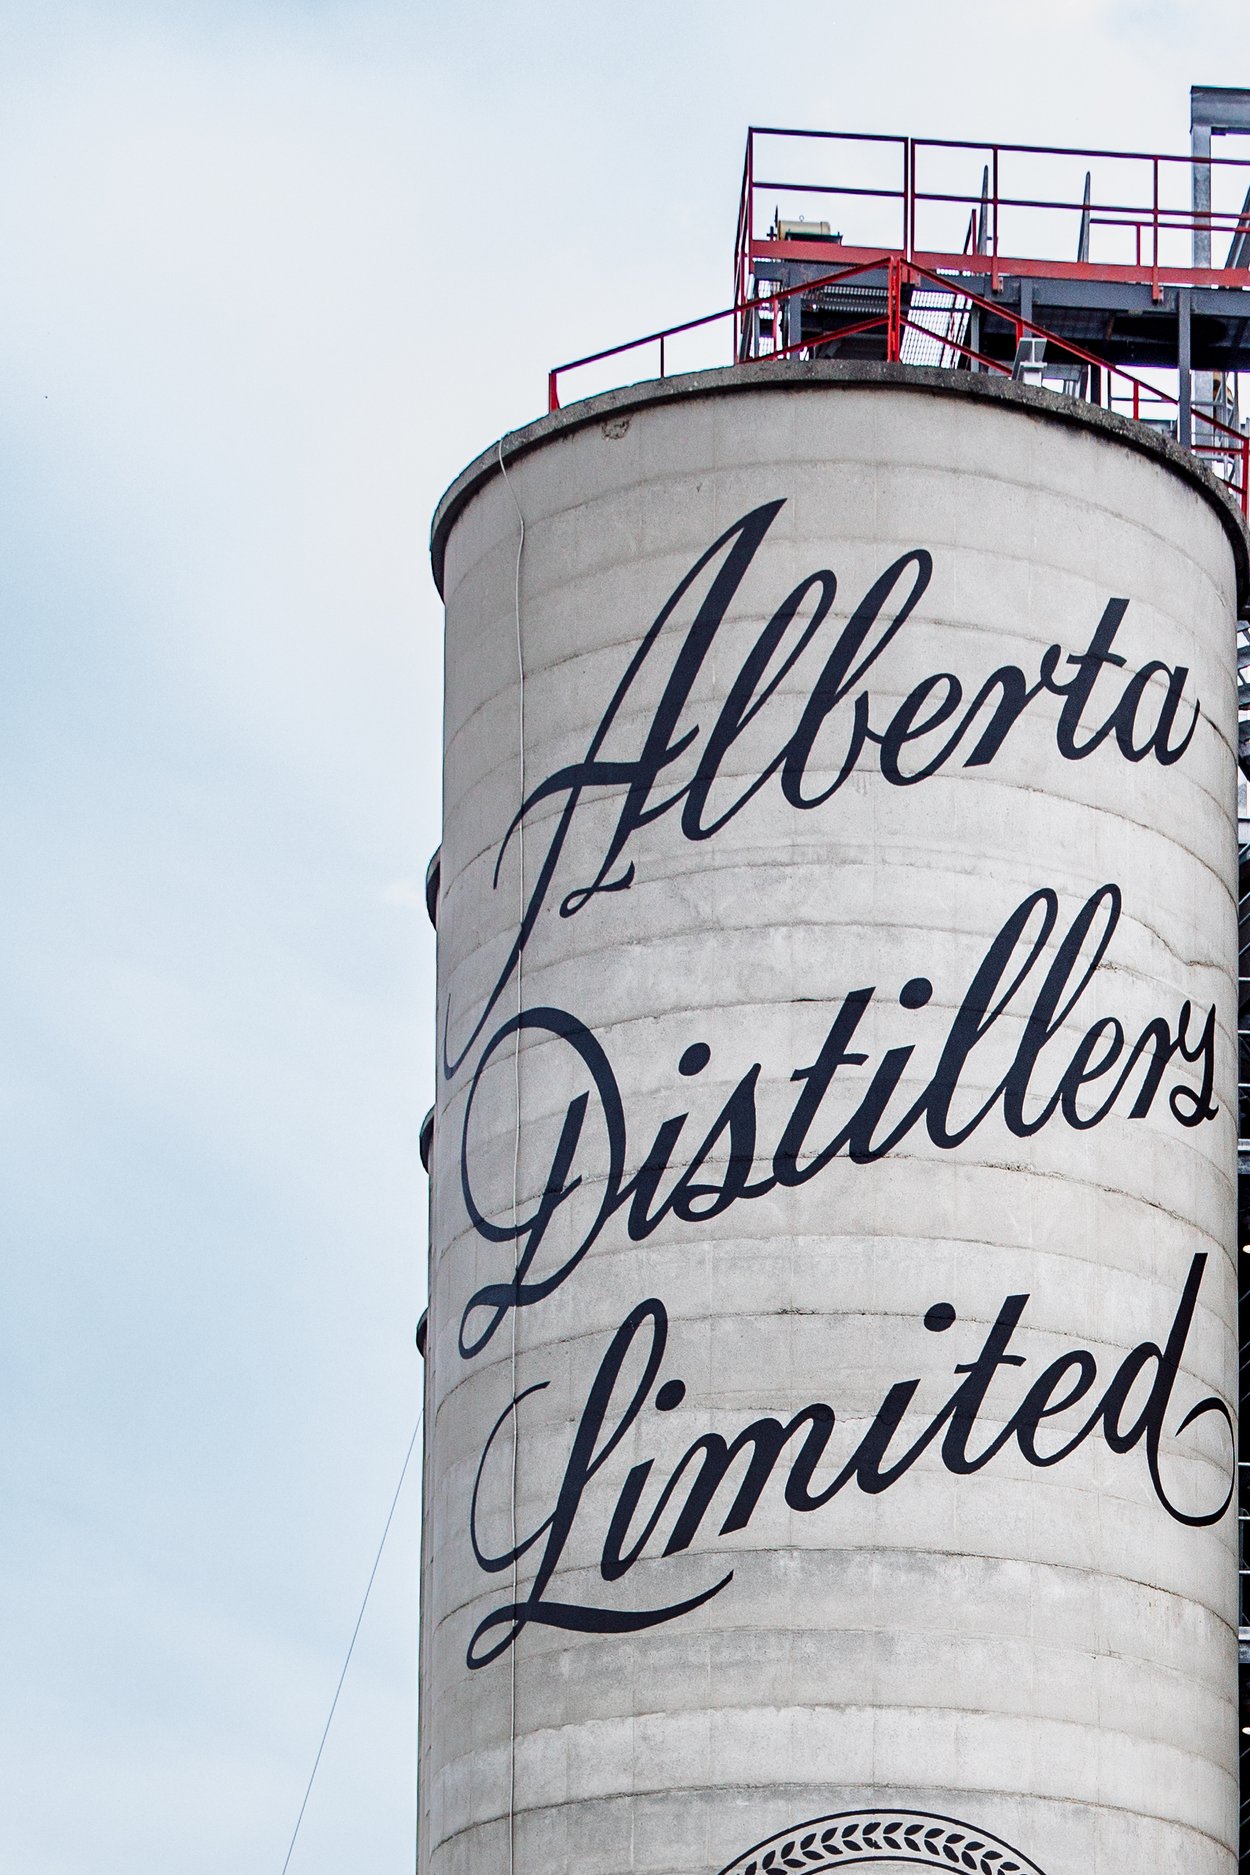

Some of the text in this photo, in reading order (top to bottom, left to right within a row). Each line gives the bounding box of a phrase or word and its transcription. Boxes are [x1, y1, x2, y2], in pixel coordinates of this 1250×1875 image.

[444, 498, 1201, 1080] Alberta
[458, 883, 1220, 1360] Distillers
[467, 1252, 1237, 1671] Limited
